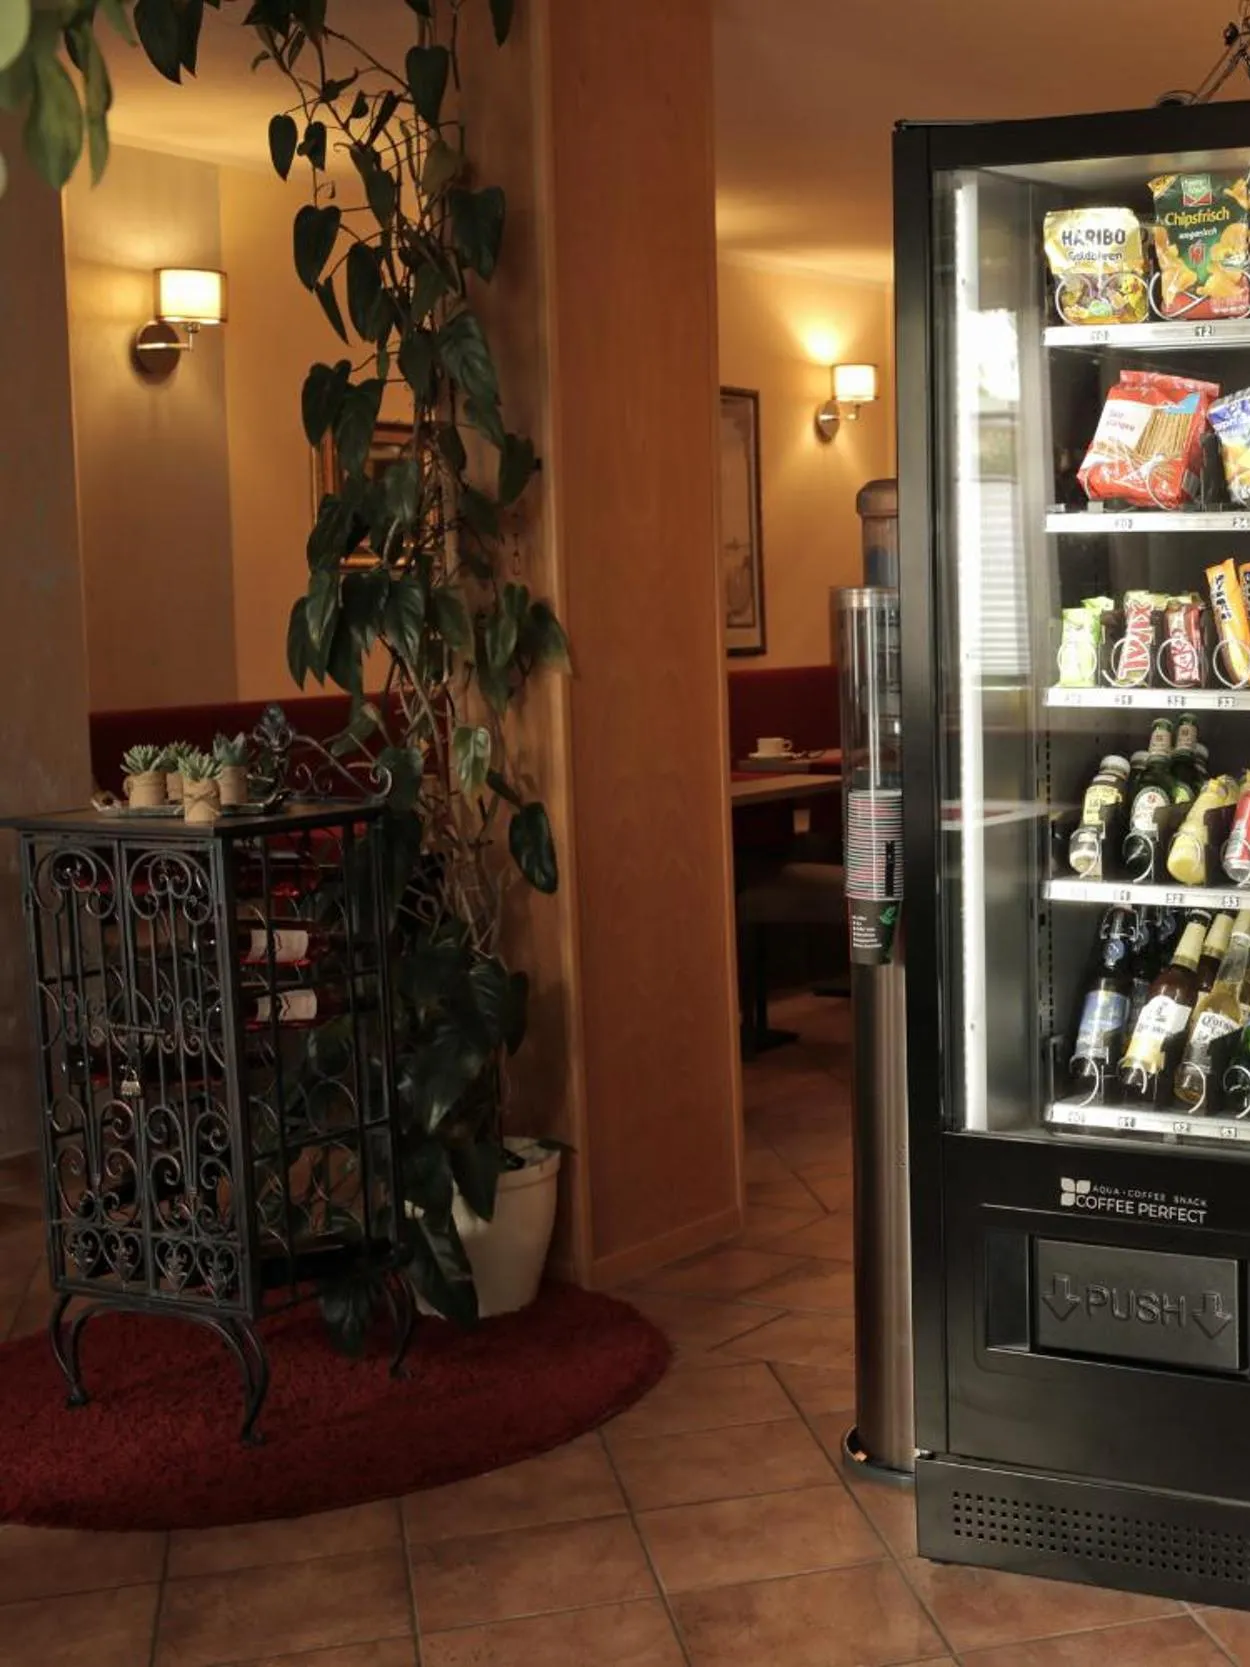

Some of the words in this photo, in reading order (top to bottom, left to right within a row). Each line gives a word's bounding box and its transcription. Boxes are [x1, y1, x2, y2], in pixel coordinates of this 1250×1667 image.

[1164, 206, 1230, 229] Chipsfrisch
[1061, 227, 1126, 247] HARIBO
[1093, 1184, 1120, 1196] AQUA
[1127, 1189, 1166, 1202] COFFEE
[1173, 1195, 1207, 1207] SNACK
[1075, 1194, 1135, 1215] COFFEE
[1137, 1202, 1208, 1224] PERFECT
[1086, 1284, 1187, 1328] PUSH
